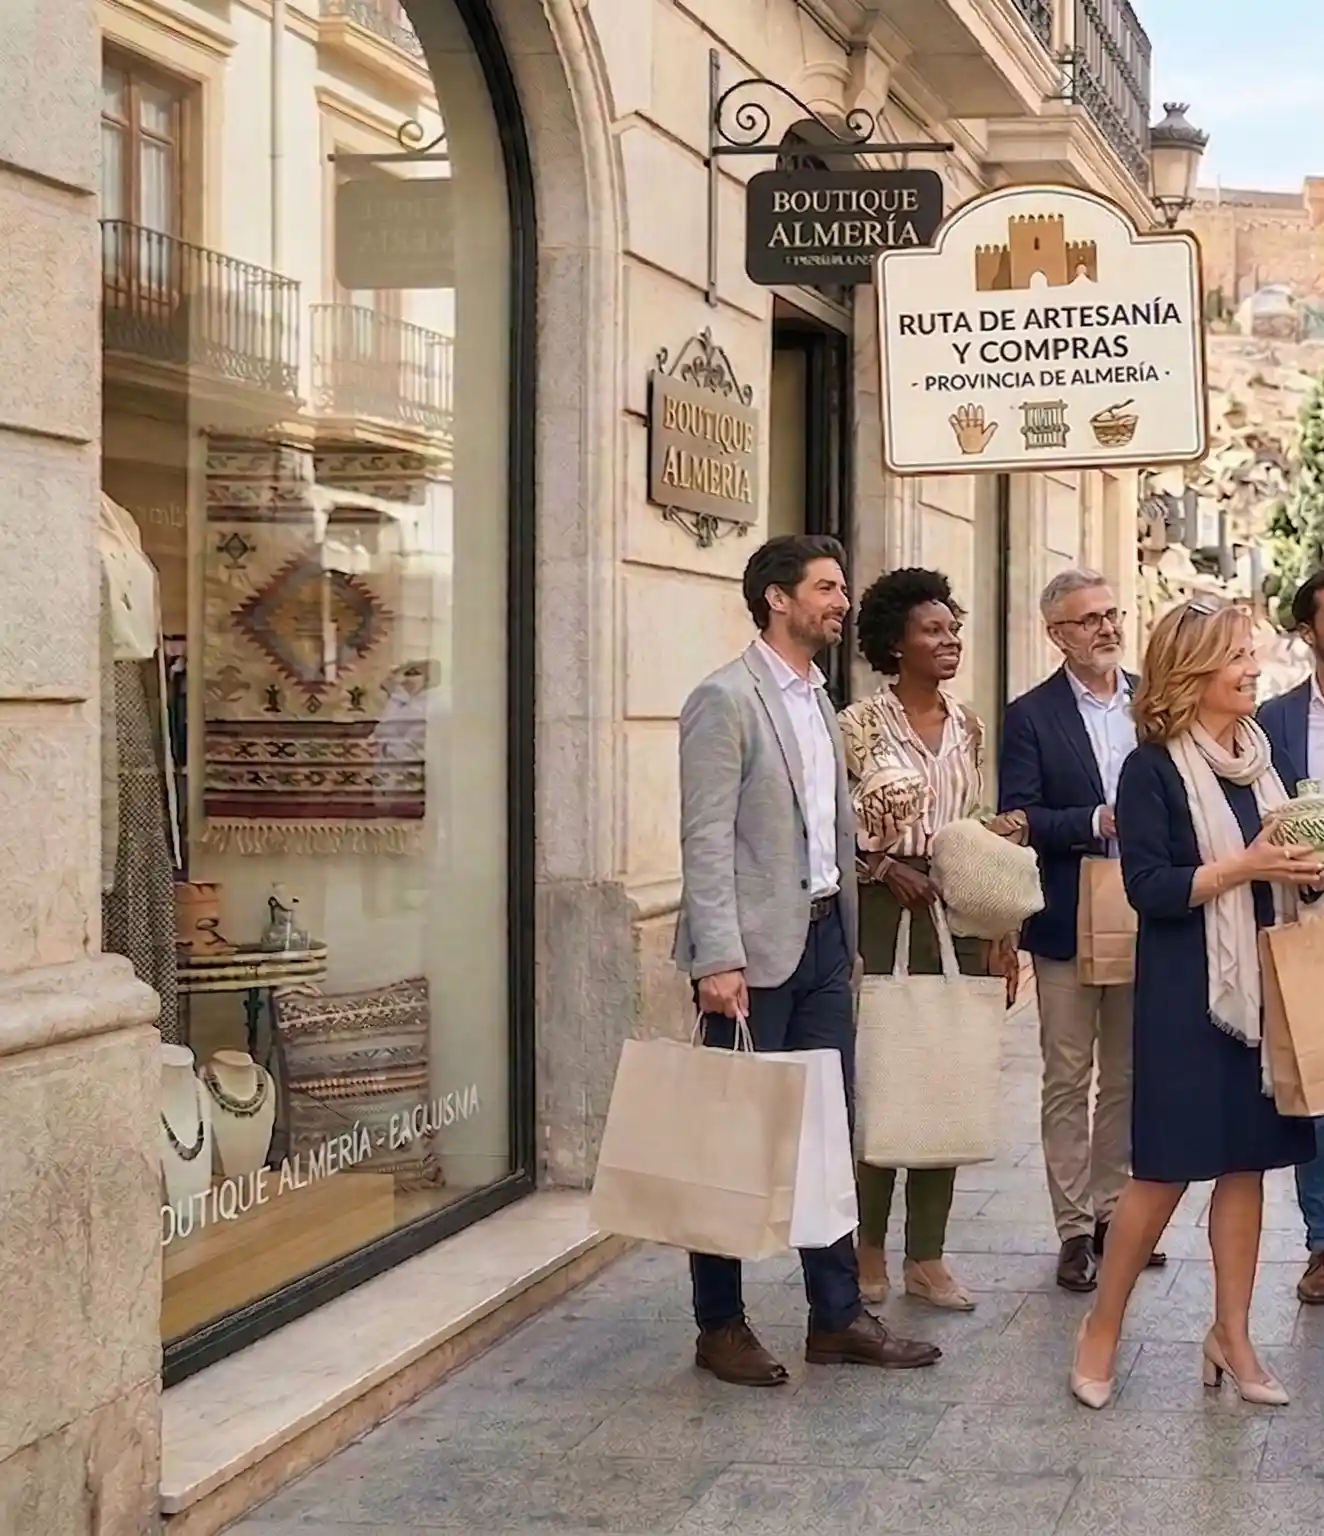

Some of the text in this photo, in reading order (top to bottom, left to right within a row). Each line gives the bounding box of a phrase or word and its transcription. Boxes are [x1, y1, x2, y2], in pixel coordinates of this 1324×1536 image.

[772, 189, 919, 217] BOUTIQUE
[767, 213, 920, 248] ALMERÍA
[899, 296, 1182, 336] RUTA DE ARTESANÍA
[951, 334, 1129, 365] Y COMPRAS
[924, 371, 1036, 391] PROVINCIA
[1040, 369, 1067, 386] DE
[1071, 361, 1160, 385] ALMERÍA
[663, 395, 754, 454] BOUTIQUE
[662, 445, 753, 503] ALMERÍA
[277, 1119, 372, 1196] ALMERÍA
